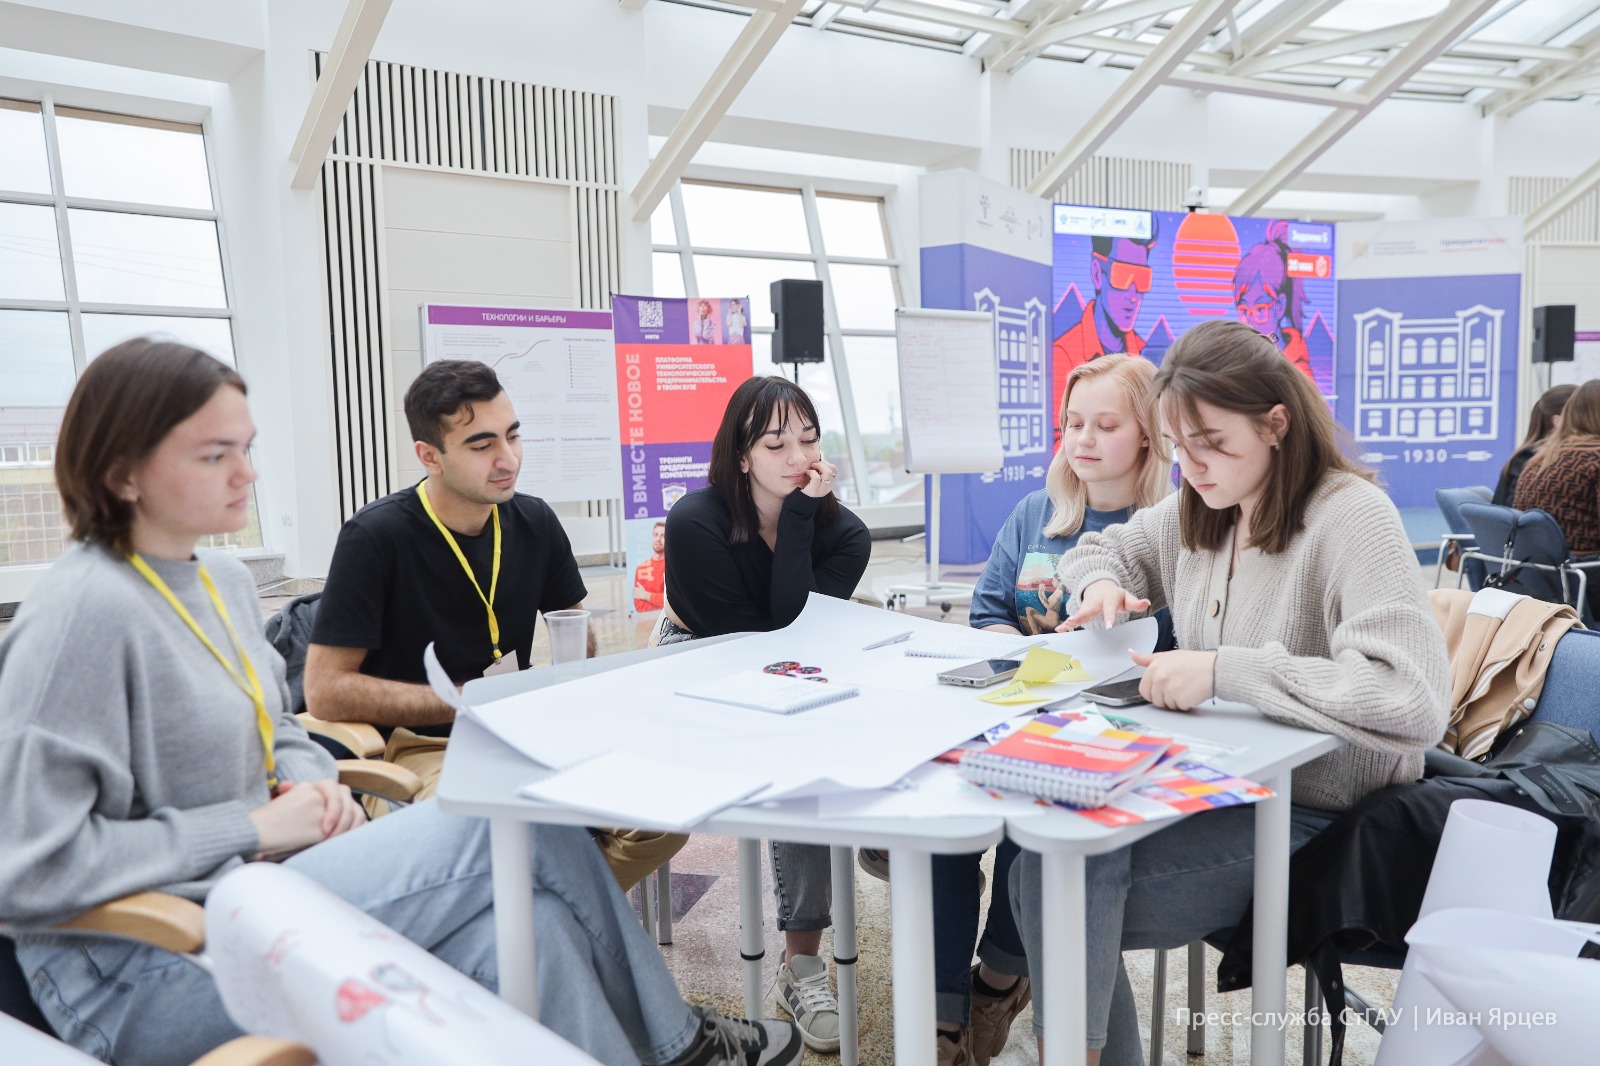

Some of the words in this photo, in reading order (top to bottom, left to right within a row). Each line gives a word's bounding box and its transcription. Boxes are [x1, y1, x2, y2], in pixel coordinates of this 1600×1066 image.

[482, 312, 527, 322] ТЕХНОЛОГИИ
[528, 314, 534, 323] И
[535, 315, 567, 324] БАРЬЕРЫ
[625, 353, 643, 422] НОВОЕ
[659, 456, 693, 465] ТРЕНИНГИ
[1403, 449, 1448, 464] 1930
[630, 427, 648, 503] ВМЕСТЕ
[1003, 465, 1026, 482] 1930
